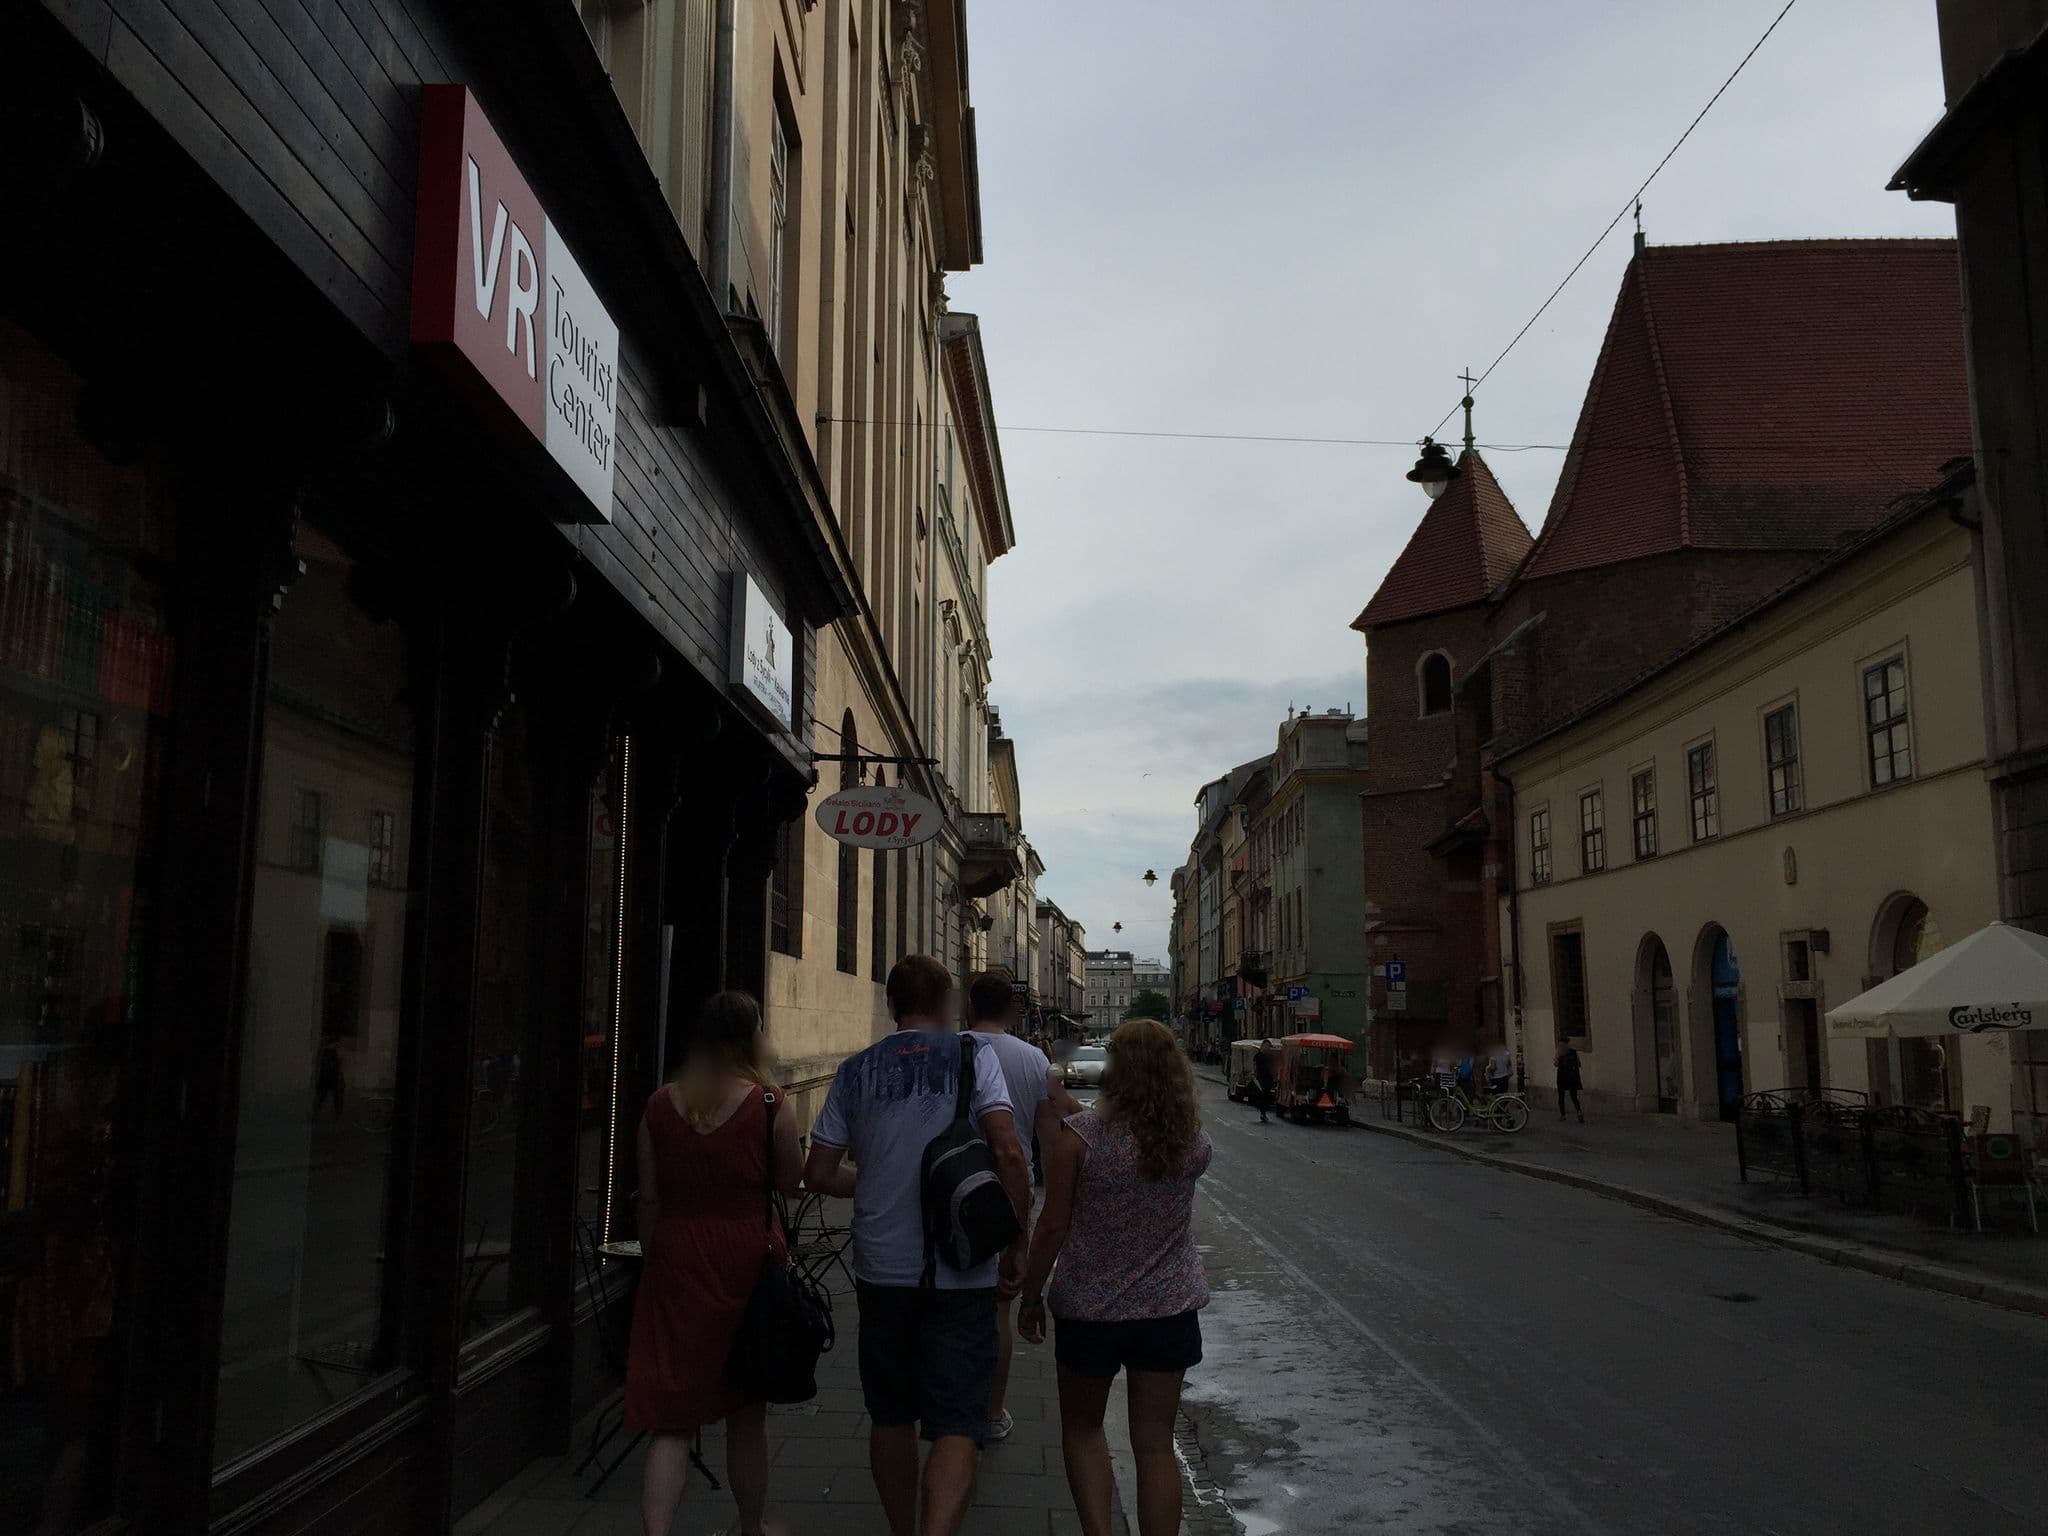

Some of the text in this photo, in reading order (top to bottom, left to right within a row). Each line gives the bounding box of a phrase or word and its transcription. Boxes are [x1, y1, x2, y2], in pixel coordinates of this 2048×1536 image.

[467, 153, 540, 383] VR
[551, 274, 613, 413] Tourist
[550, 352, 611, 471] Center
[834, 810, 922, 838] LODY
[1390, 963, 1402, 979] P
[1235, 999, 1243, 1010] P
[1289, 988, 1299, 1000] P
[1948, 1002, 2032, 1031] Carlsberg
